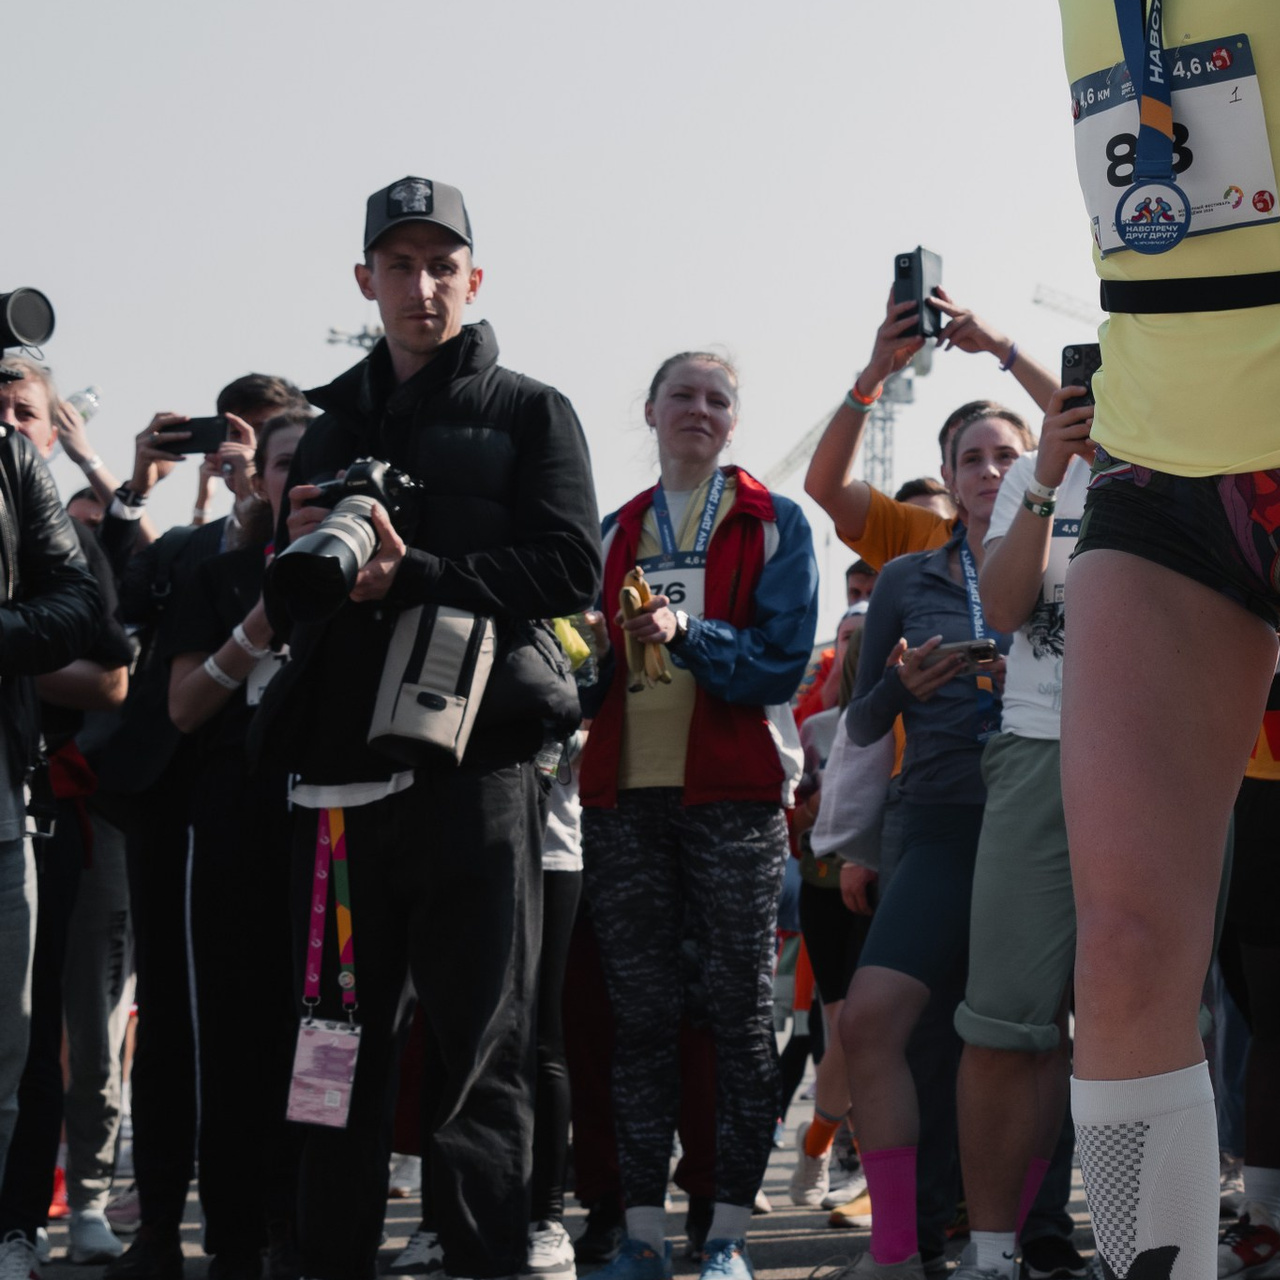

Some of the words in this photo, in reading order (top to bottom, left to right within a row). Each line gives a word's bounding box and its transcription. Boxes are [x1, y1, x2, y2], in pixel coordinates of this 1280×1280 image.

[1173, 57, 1202, 81] 4,6
[1125, 224, 1179, 233] НАВСТРЕЧУ
[1125, 232, 1150, 240] ДРУГ
[1149, 231, 1179, 240] ДРУГУ
[1061, 523, 1079, 534] 4,6
